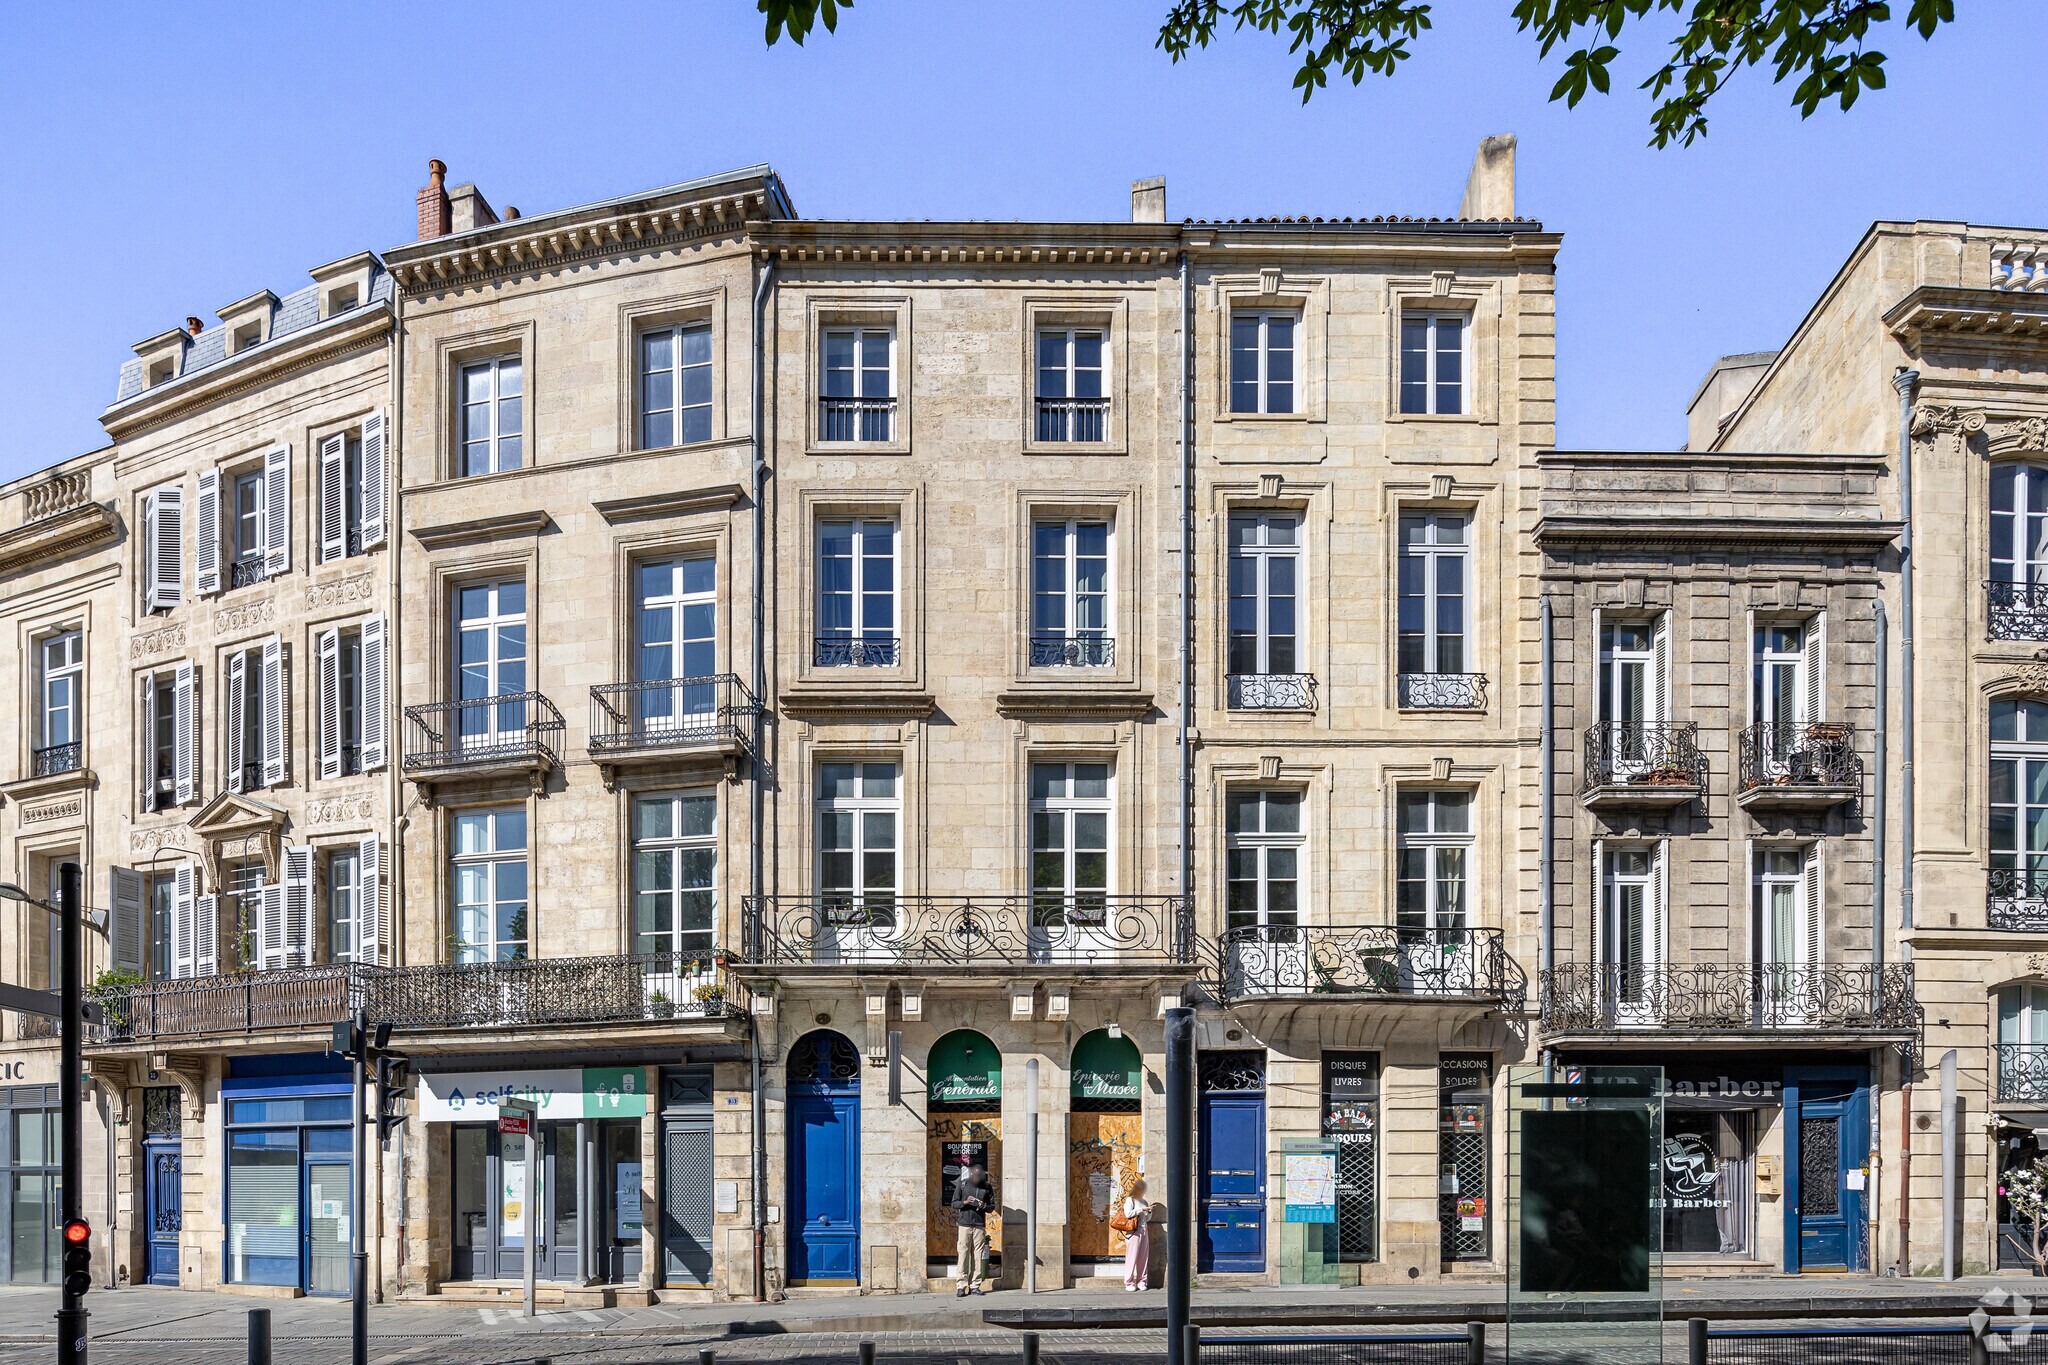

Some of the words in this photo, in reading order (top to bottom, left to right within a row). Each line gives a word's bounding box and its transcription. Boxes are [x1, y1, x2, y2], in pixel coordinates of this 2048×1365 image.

[0, 1061, 25, 1080] IC
[1331, 1061, 1367, 1070] DISQUES
[1438, 1060, 1488, 1069] OCCASIONS
[944, 1074, 988, 1082] Alimentation
[1072, 1069, 1121, 1085] Epicerie
[1334, 1077, 1362, 1086] LIVRES
[1445, 1077, 1478, 1086] SOLDES
[931, 1079, 999, 1101] Générale
[1082, 1080, 1094, 1089] du
[1086, 1079, 1139, 1095] Musée
[1652, 1076, 1782, 1098] Barber
[475, 1084, 554, 1109] selfcity
[1323, 1110, 1343, 1129] BAM
[1344, 1108, 1374, 1130] BALAM
[1325, 1133, 1372, 1145] DISQUES
[1672, 1197, 1731, 1209] Barber
